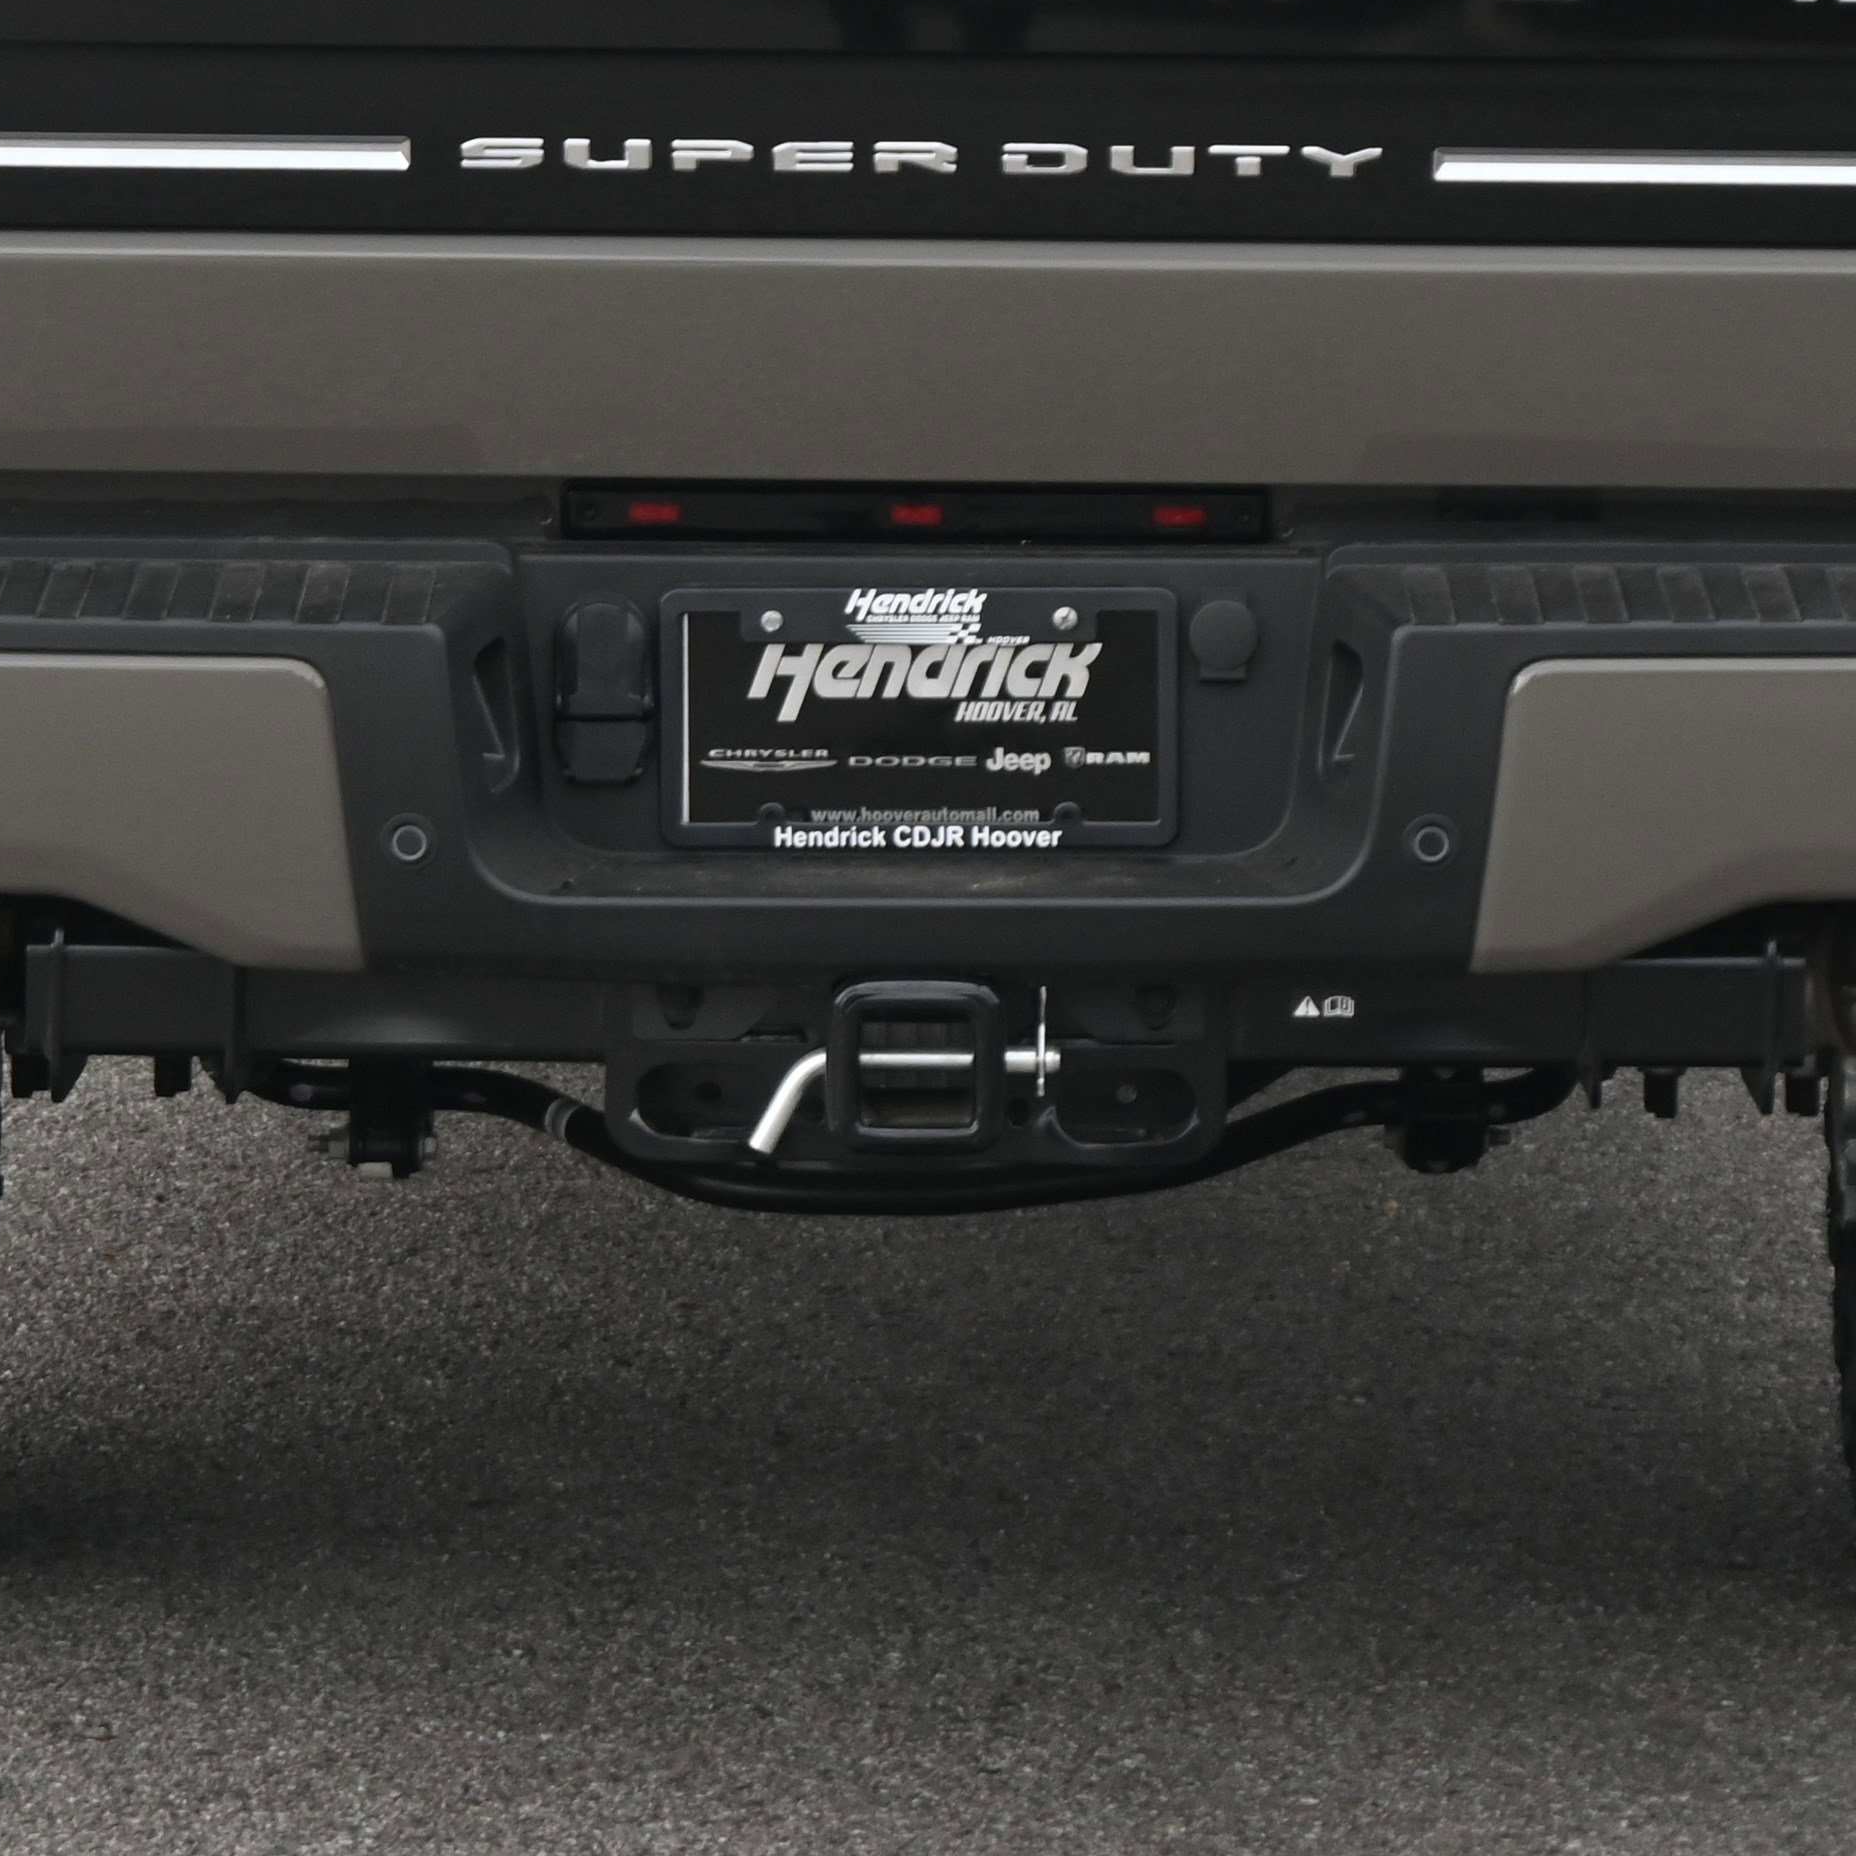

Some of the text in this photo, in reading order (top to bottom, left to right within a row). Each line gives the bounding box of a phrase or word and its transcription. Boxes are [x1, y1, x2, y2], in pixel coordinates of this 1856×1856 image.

[459, 137, 1384, 177] SUPER DUTY
[844, 588, 988, 622] Hendrick
[987, 635, 1031, 644] HOOVER
[746, 643, 1104, 722] Hendrick
[954, 701, 1079, 724] HOOVER, AL
[707, 748, 829, 758] CHRYSLER
[847, 755, 978, 767] DODGE
[985, 746, 1052, 775] Jeep
[1085, 751, 1151, 764] RAM
[810, 806, 1040, 823] www.hooverautomall.com
[773, 825, 1063, 847] Hendrick CDJR Hoover
